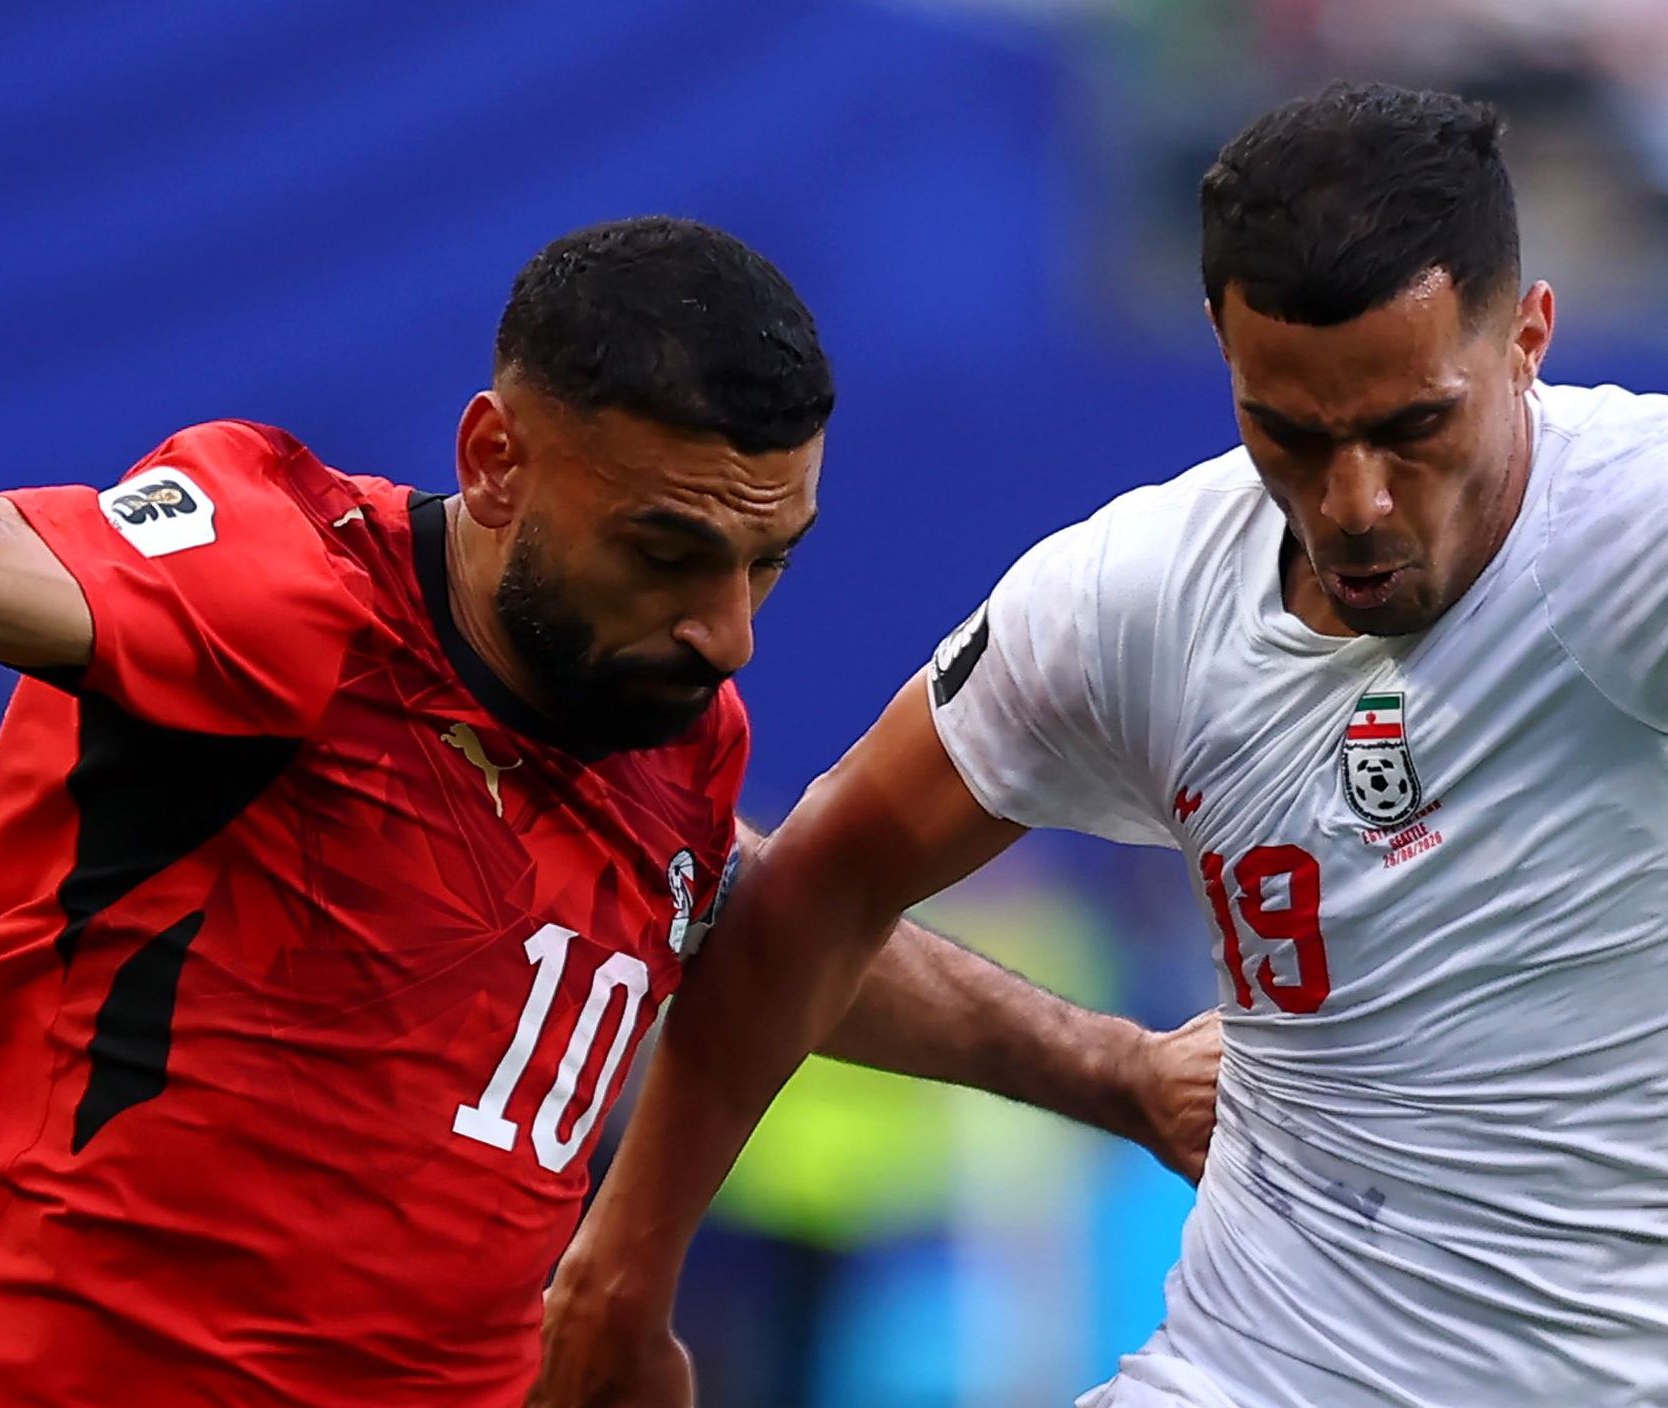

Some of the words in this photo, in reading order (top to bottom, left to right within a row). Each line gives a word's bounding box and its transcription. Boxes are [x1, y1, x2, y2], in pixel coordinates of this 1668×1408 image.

[1382, 831, 1443, 869] 26/06/2026
[1389, 822, 1429, 851] SEATTLE
[1200, 844, 1331, 1014] 19
[452, 923, 649, 1173] 10
